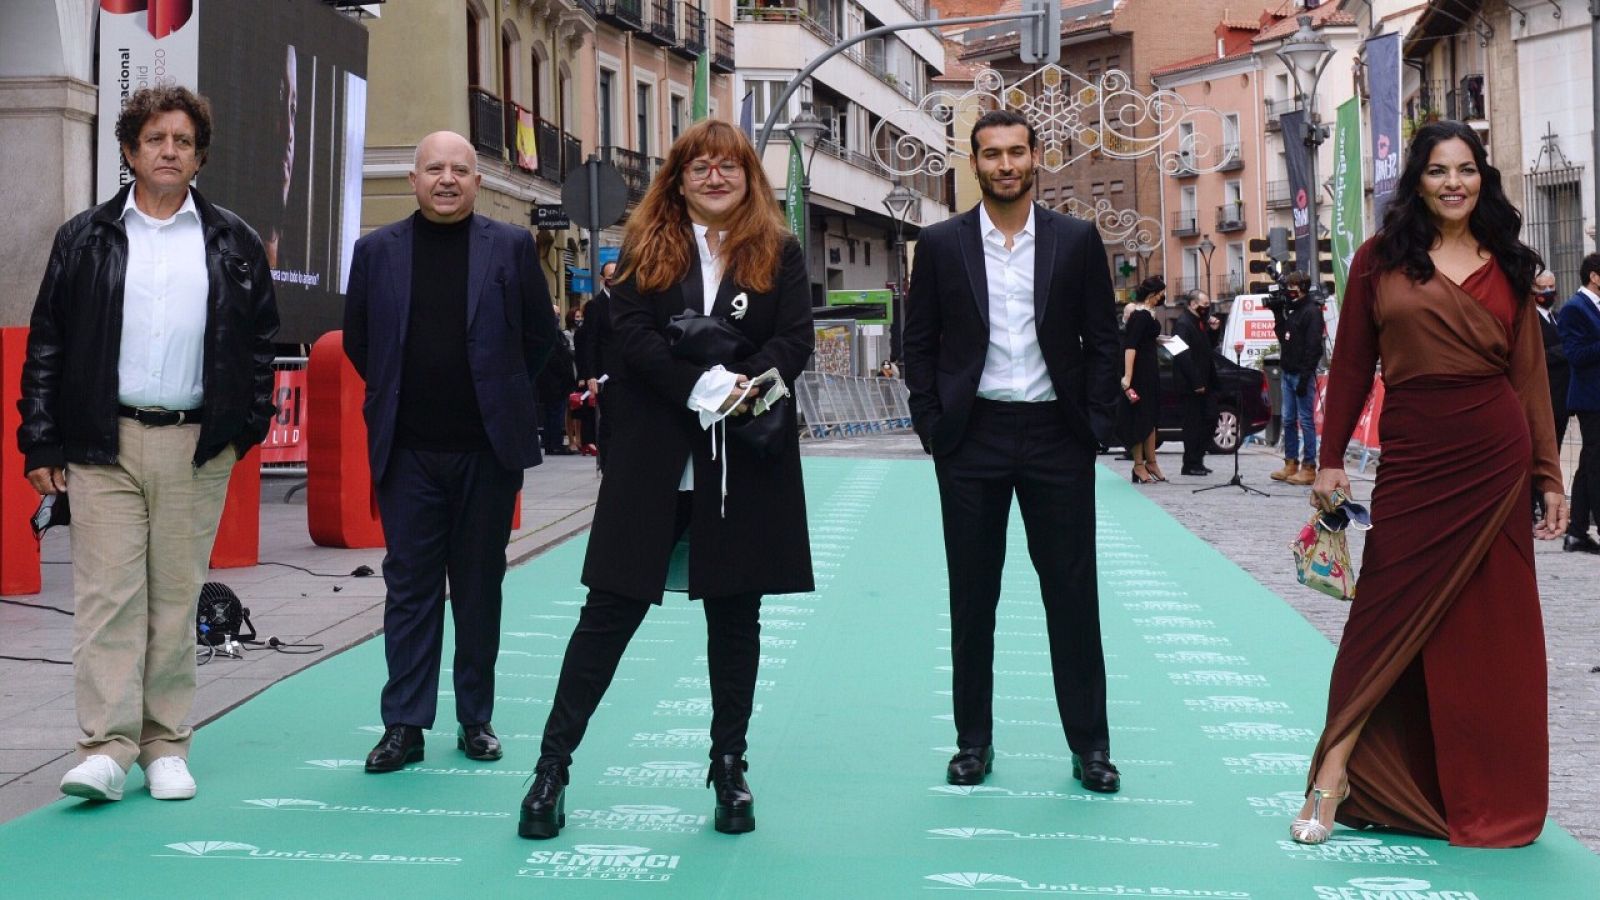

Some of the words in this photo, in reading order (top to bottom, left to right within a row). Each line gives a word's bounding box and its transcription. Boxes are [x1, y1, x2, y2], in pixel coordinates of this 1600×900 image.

[1250, 330, 1276, 338] RENTA
[276, 386, 301, 427] CI
[272, 429, 300, 445] LID
[568, 809, 708, 825] SEMINCI
[249, 849, 362, 862] Unicaja
[369, 854, 463, 863] Banco
[526, 850, 681, 869] SEMINCI
[1021, 882, 1146, 896] Unicaja
[1150, 887, 1250, 897] Banco
